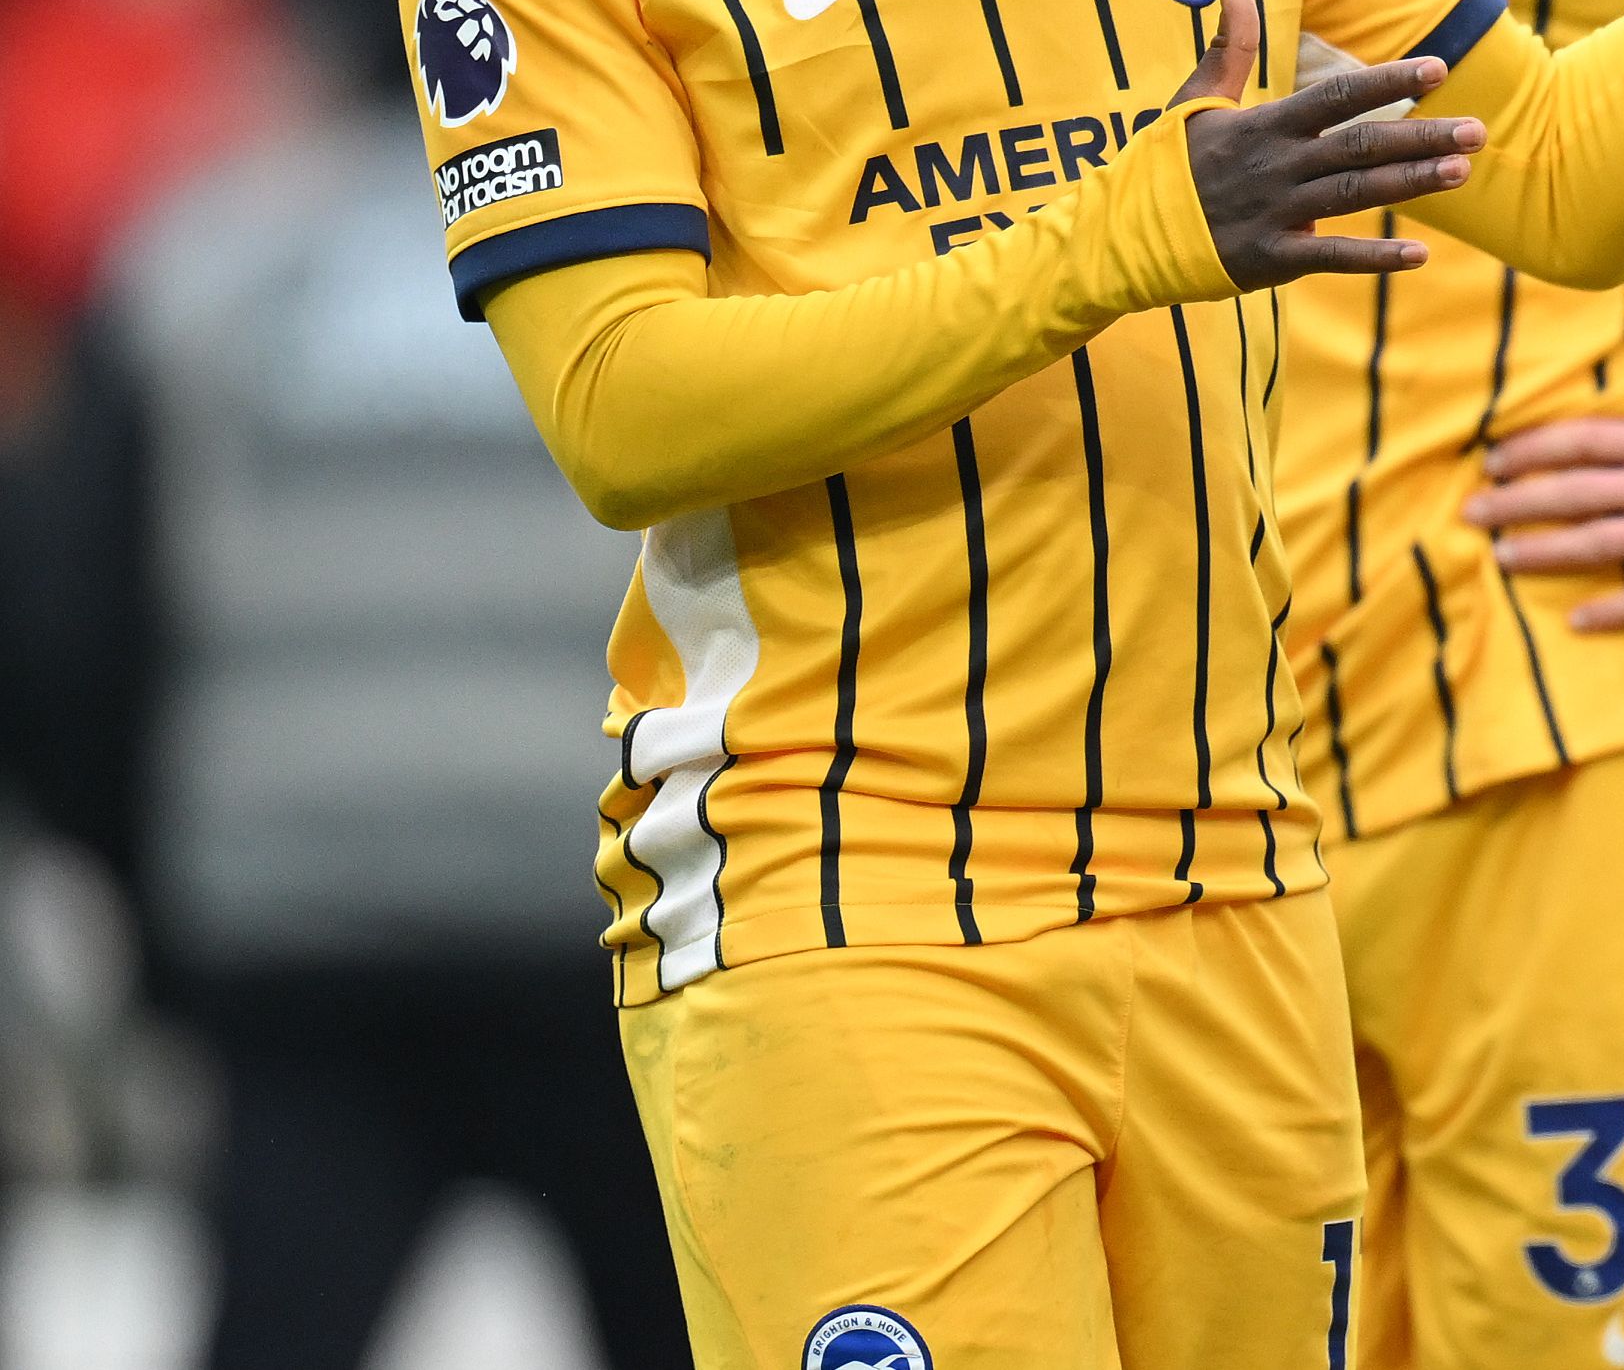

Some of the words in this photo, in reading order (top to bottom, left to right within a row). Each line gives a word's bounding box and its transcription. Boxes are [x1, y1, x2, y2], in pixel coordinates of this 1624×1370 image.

[435, 165, 460, 196] No
[461, 139, 544, 185] room
[463, 163, 562, 213] racism
[813, 1317, 859, 1356] BRIGHTON
[864, 1317, 873, 1327] &
[878, 1320, 907, 1343] HOVE
